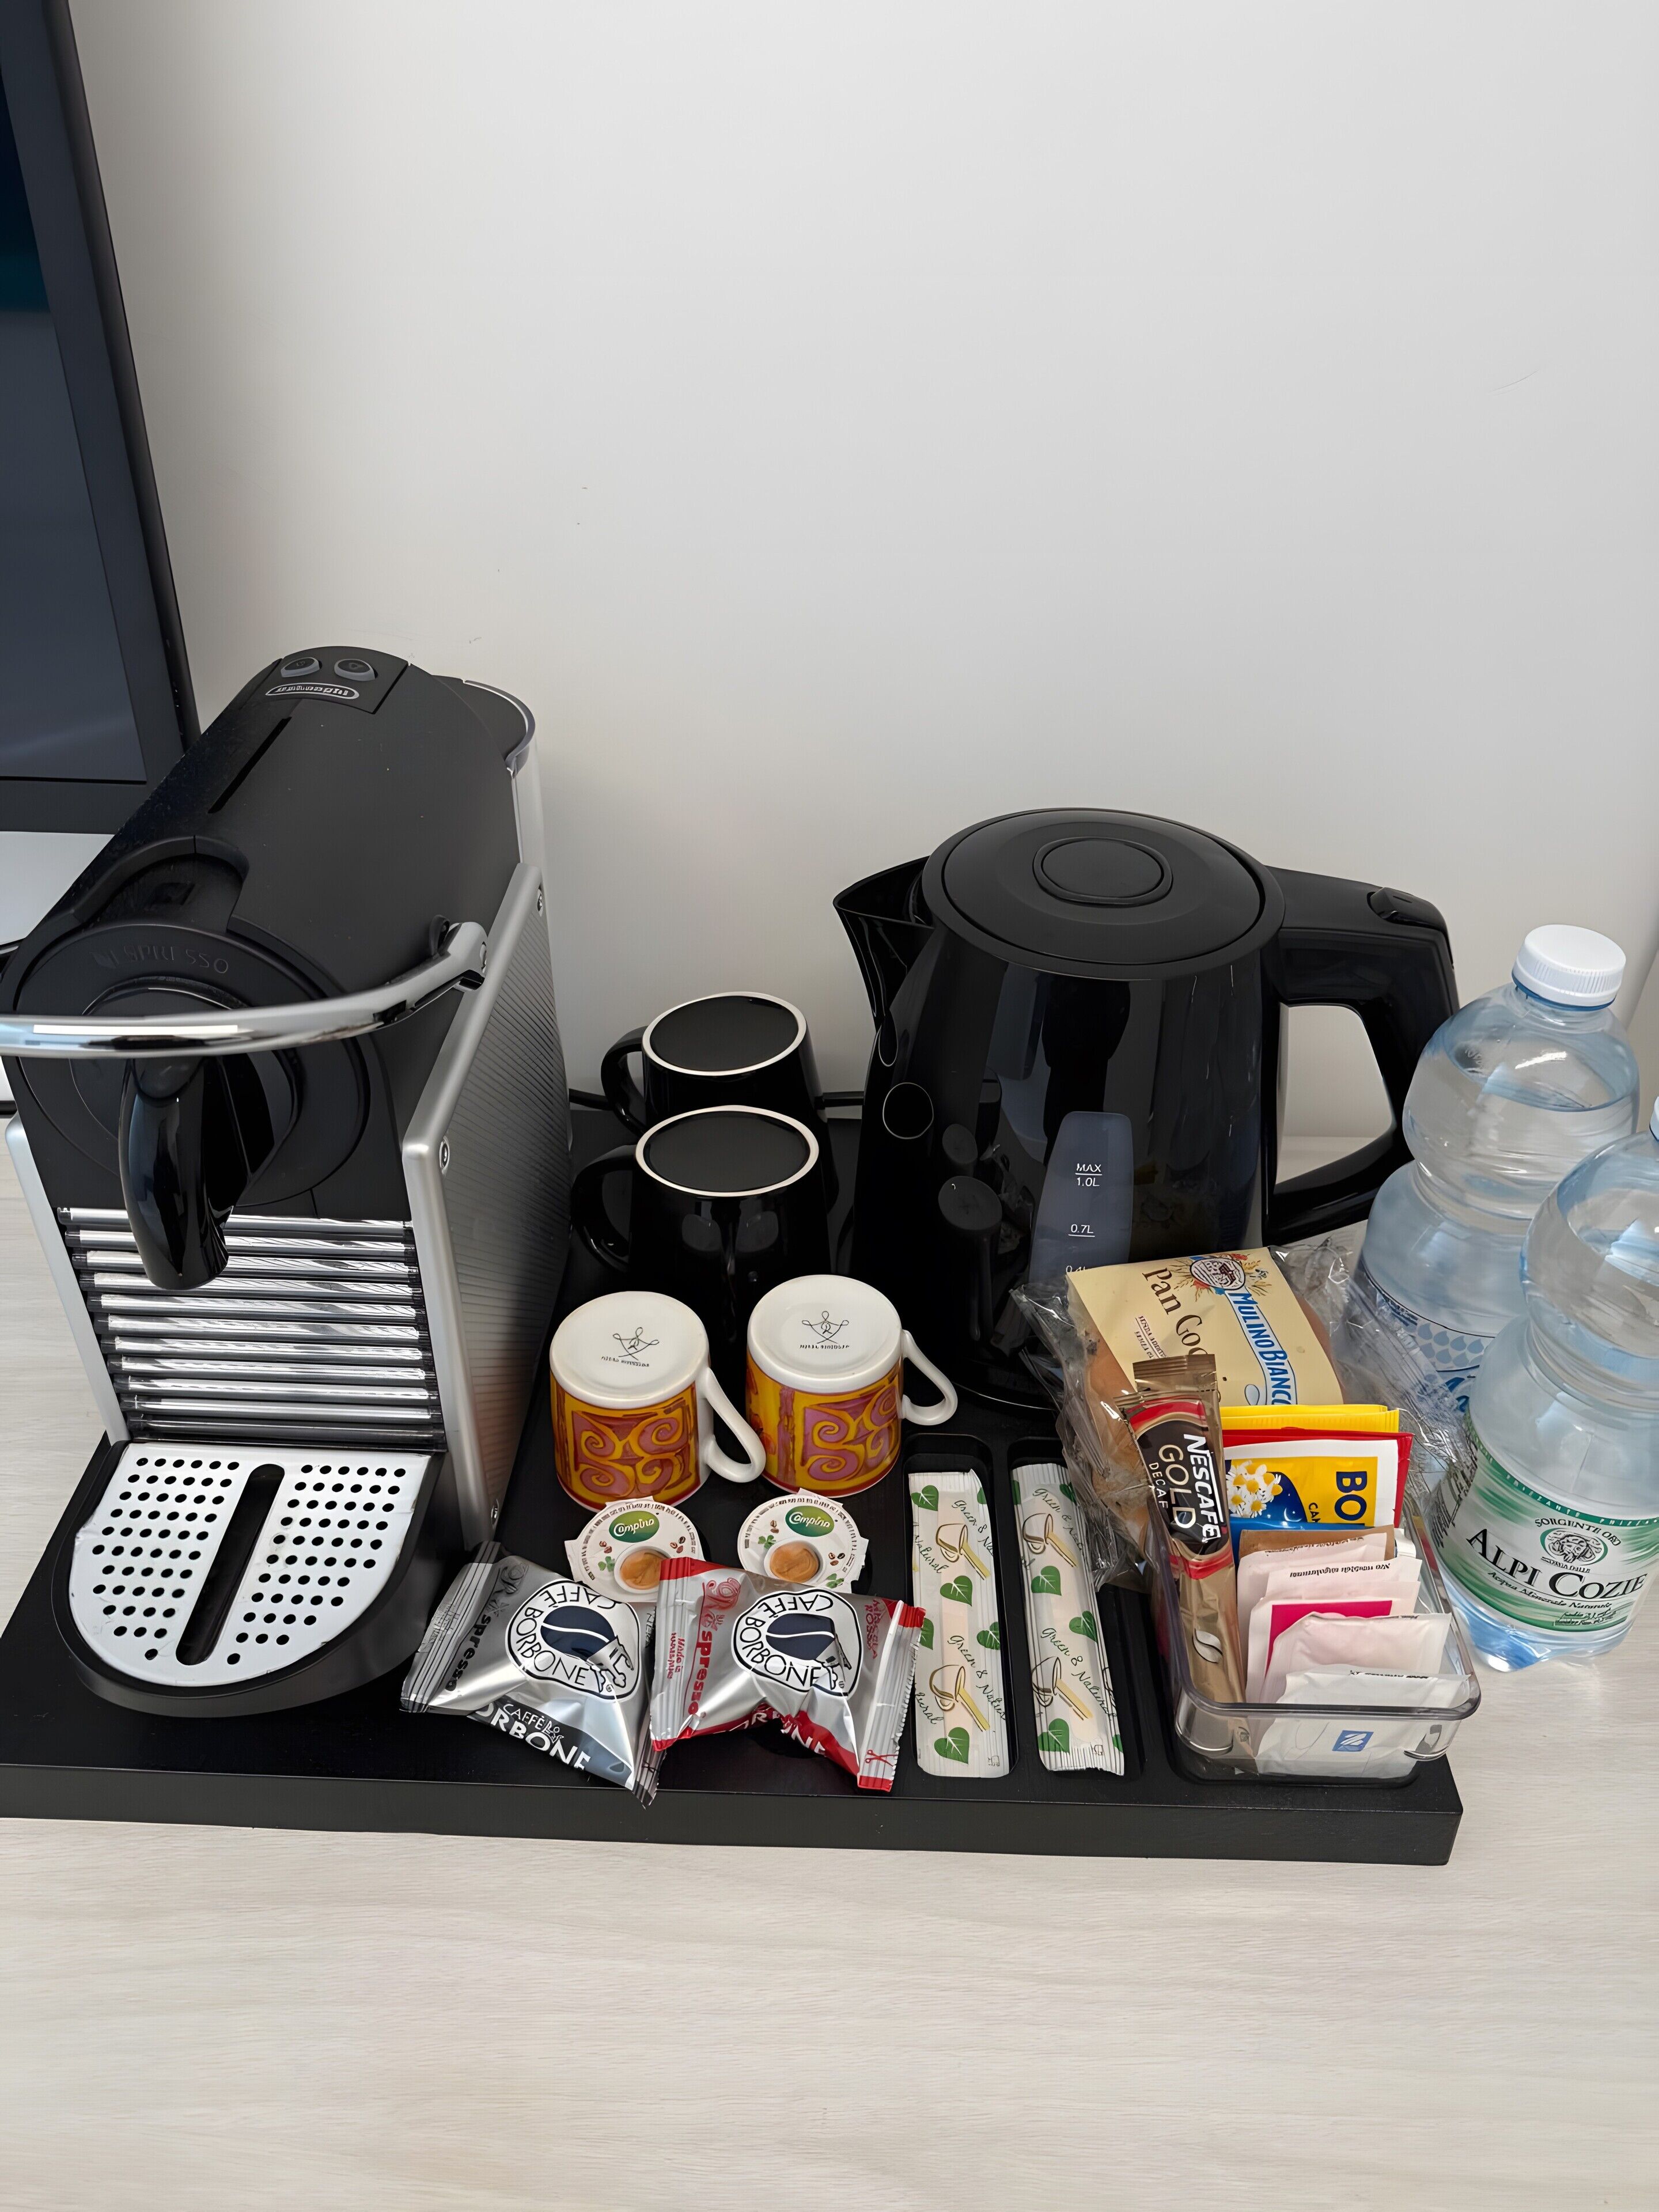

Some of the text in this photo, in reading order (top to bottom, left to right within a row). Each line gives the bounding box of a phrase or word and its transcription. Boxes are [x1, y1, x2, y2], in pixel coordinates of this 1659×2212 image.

[1076, 1163, 1101, 1172] MAX
[1077, 1177, 1100, 1187] 1.0L
[1071, 1224, 1094, 1234] 0.7L
[1141, 1267, 1181, 1315] Pan
[1227, 1293, 1275, 1348] MULINO
[1149, 1462, 1169, 1509] DECAF
[1158, 1444, 1196, 1529] GOLD
[1465, 1528, 1648, 1600] ALPI COZIE
[757, 1594, 834, 1619] CAFFÈ
[516, 1607, 589, 1686] BORBONE
[740, 1616, 822, 1688] BORBONE
